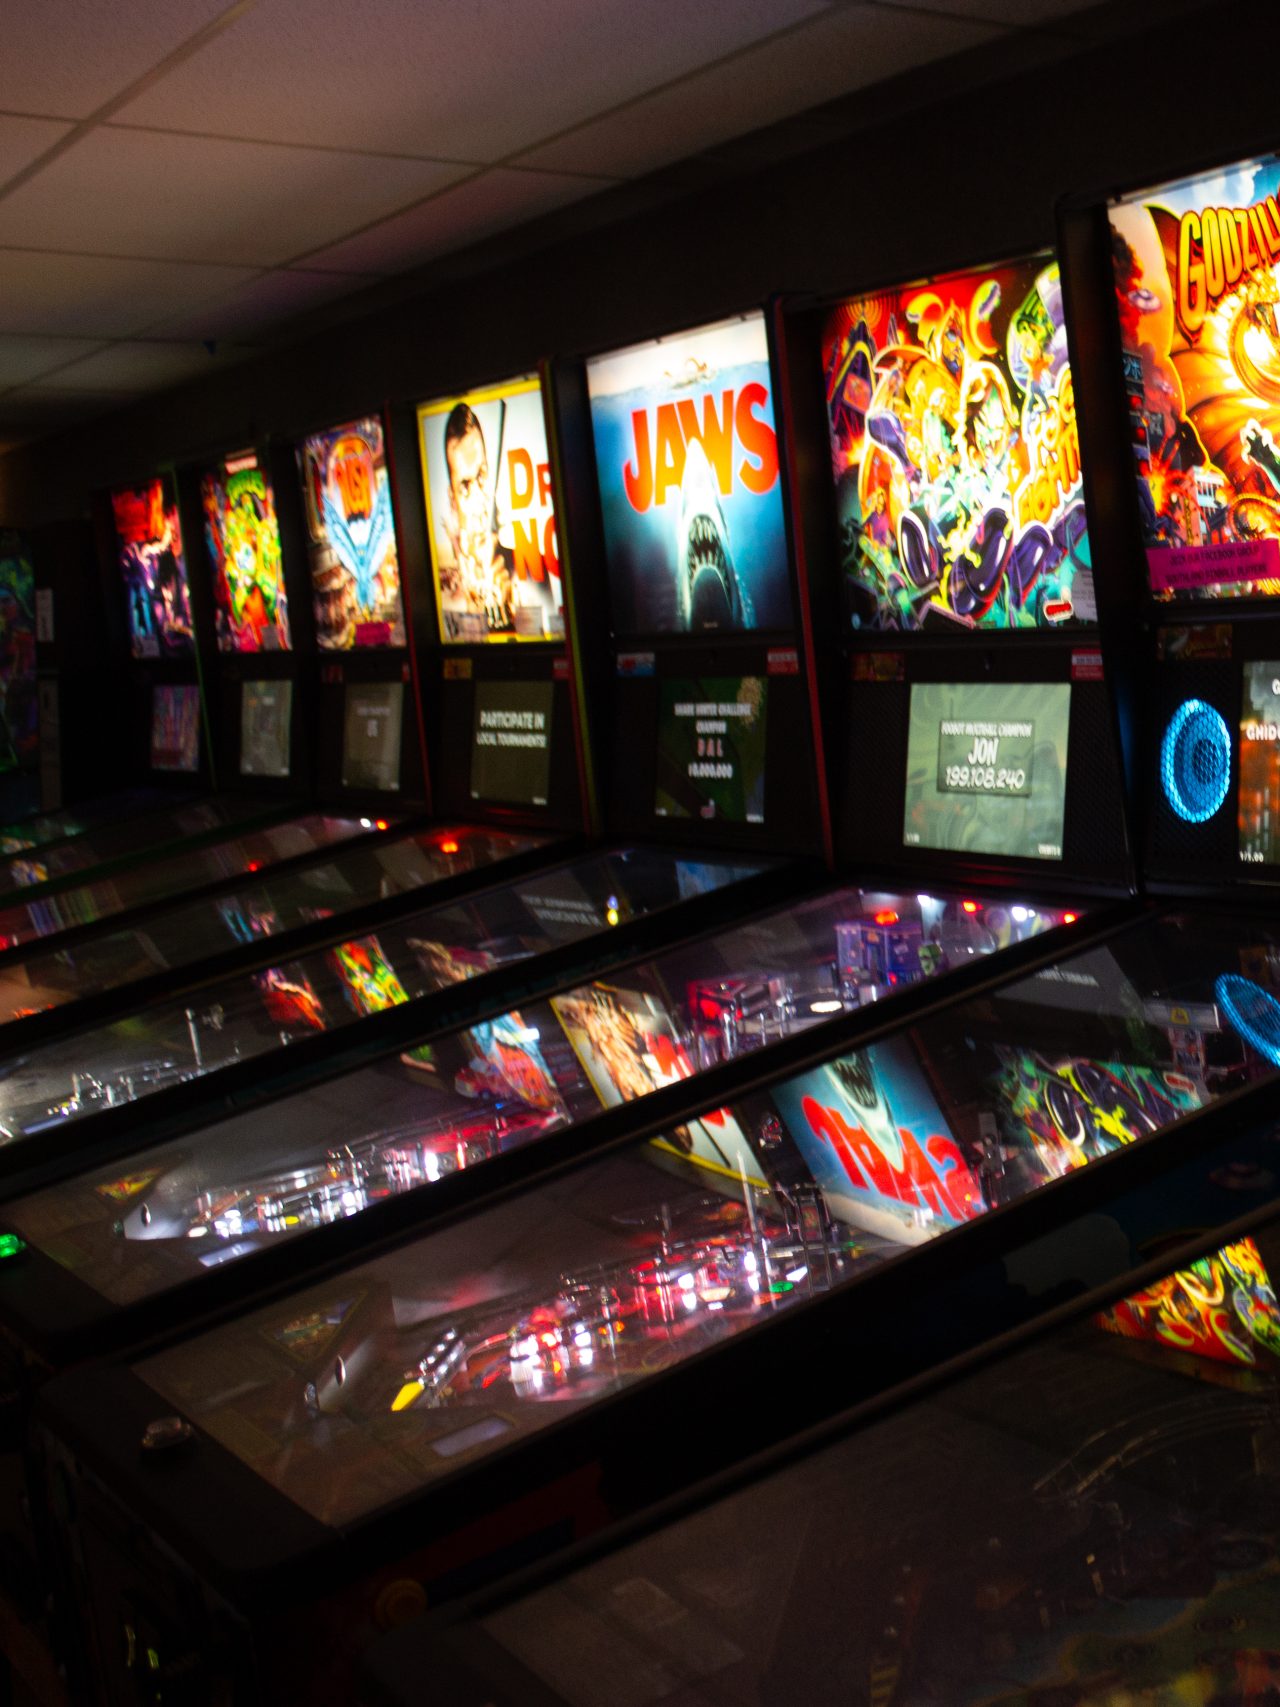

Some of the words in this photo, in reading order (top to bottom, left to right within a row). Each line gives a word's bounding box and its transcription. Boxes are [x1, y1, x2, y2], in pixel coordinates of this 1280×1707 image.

[623, 381, 779, 514] JAWS
[480, 710, 533, 730] PARTICIPATE
[534, 712, 545, 730] IN
[967, 737, 999, 766] JON
